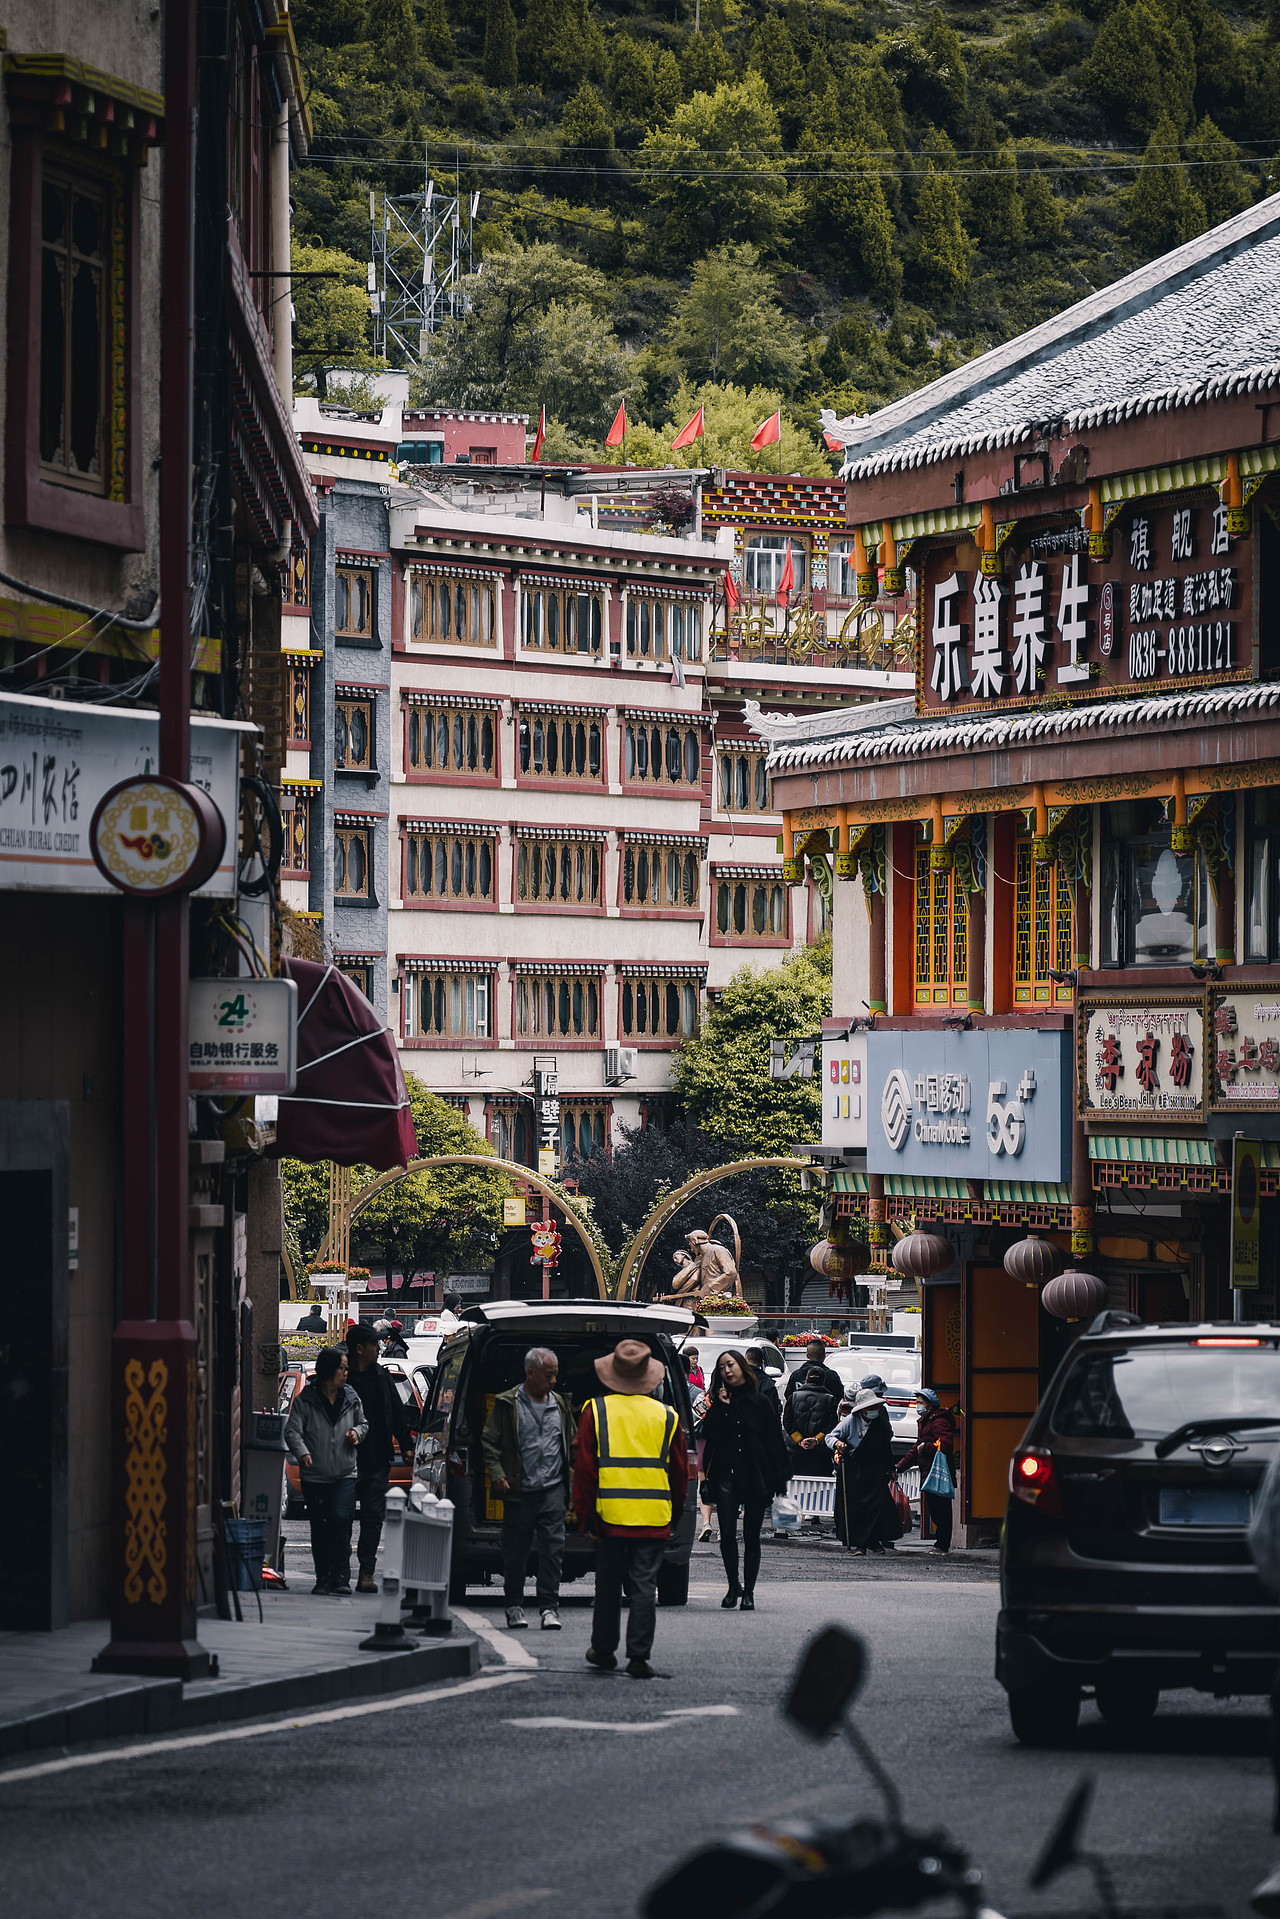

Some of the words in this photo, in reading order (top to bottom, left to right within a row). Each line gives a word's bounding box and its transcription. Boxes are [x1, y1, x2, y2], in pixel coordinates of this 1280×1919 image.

[1130, 503, 1229, 571] 旗舰店
[930, 553, 1090, 702] 乐巢养生
[1129, 621, 1232, 679] 0836-8881121
[27, 830, 52, 851] RURAL
[55, 832, 80, 852] CREDIT
[218, 994, 249, 1026] 24
[190, 1042, 279, 1058] 自助银行服务
[914, 1074, 969, 1113] 中国移动
[1100, 1093, 1118, 1109] Lee's
[1119, 1094, 1137, 1109] Bean
[1139, 1091, 1157, 1109] Jelly
